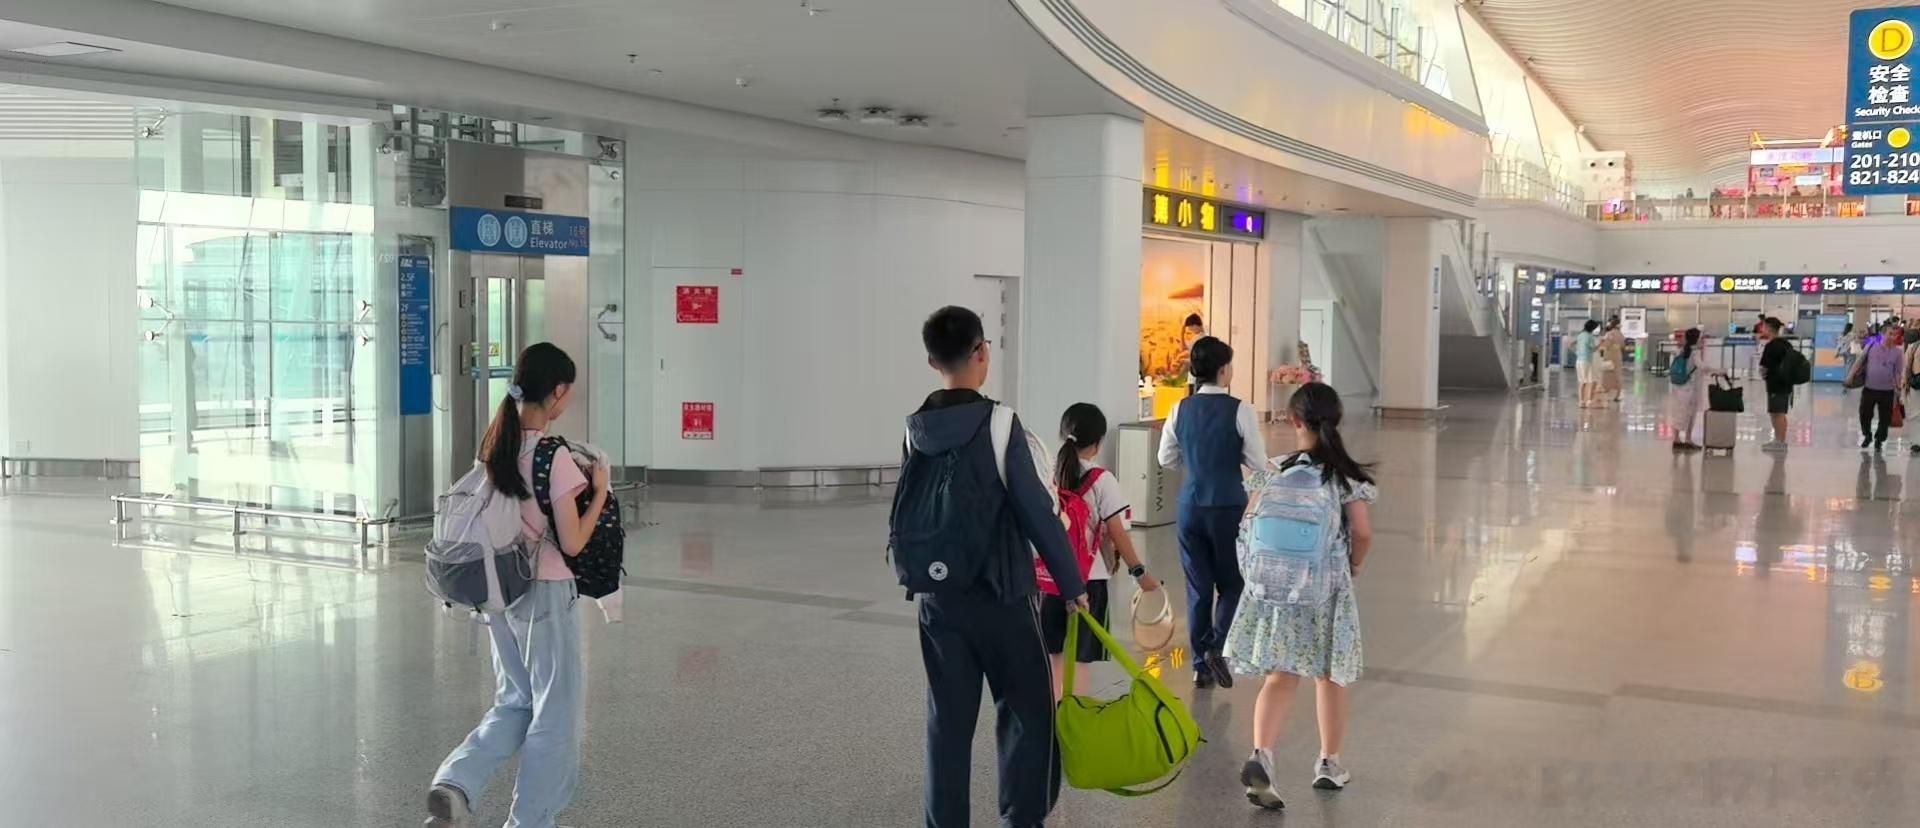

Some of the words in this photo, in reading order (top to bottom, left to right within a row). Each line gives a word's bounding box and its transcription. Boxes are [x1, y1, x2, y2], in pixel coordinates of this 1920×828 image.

[1882, 28, 1904, 52] D
[1869, 63, 1911, 83] 安全
[1868, 85, 1909, 104] 检查
[1855, 107, 1891, 117] Security
[1850, 152, 1920, 169] 201-210
[1850, 169, 1920, 184] 821-824
[530, 220, 554, 235] 直梯
[530, 237, 568, 249] Elevator
[1587, 278, 1602, 290] 12
[1612, 278, 1627, 290] 13
[1775, 278, 1791, 290] 14
[1823, 278, 1857, 290] 15-16
